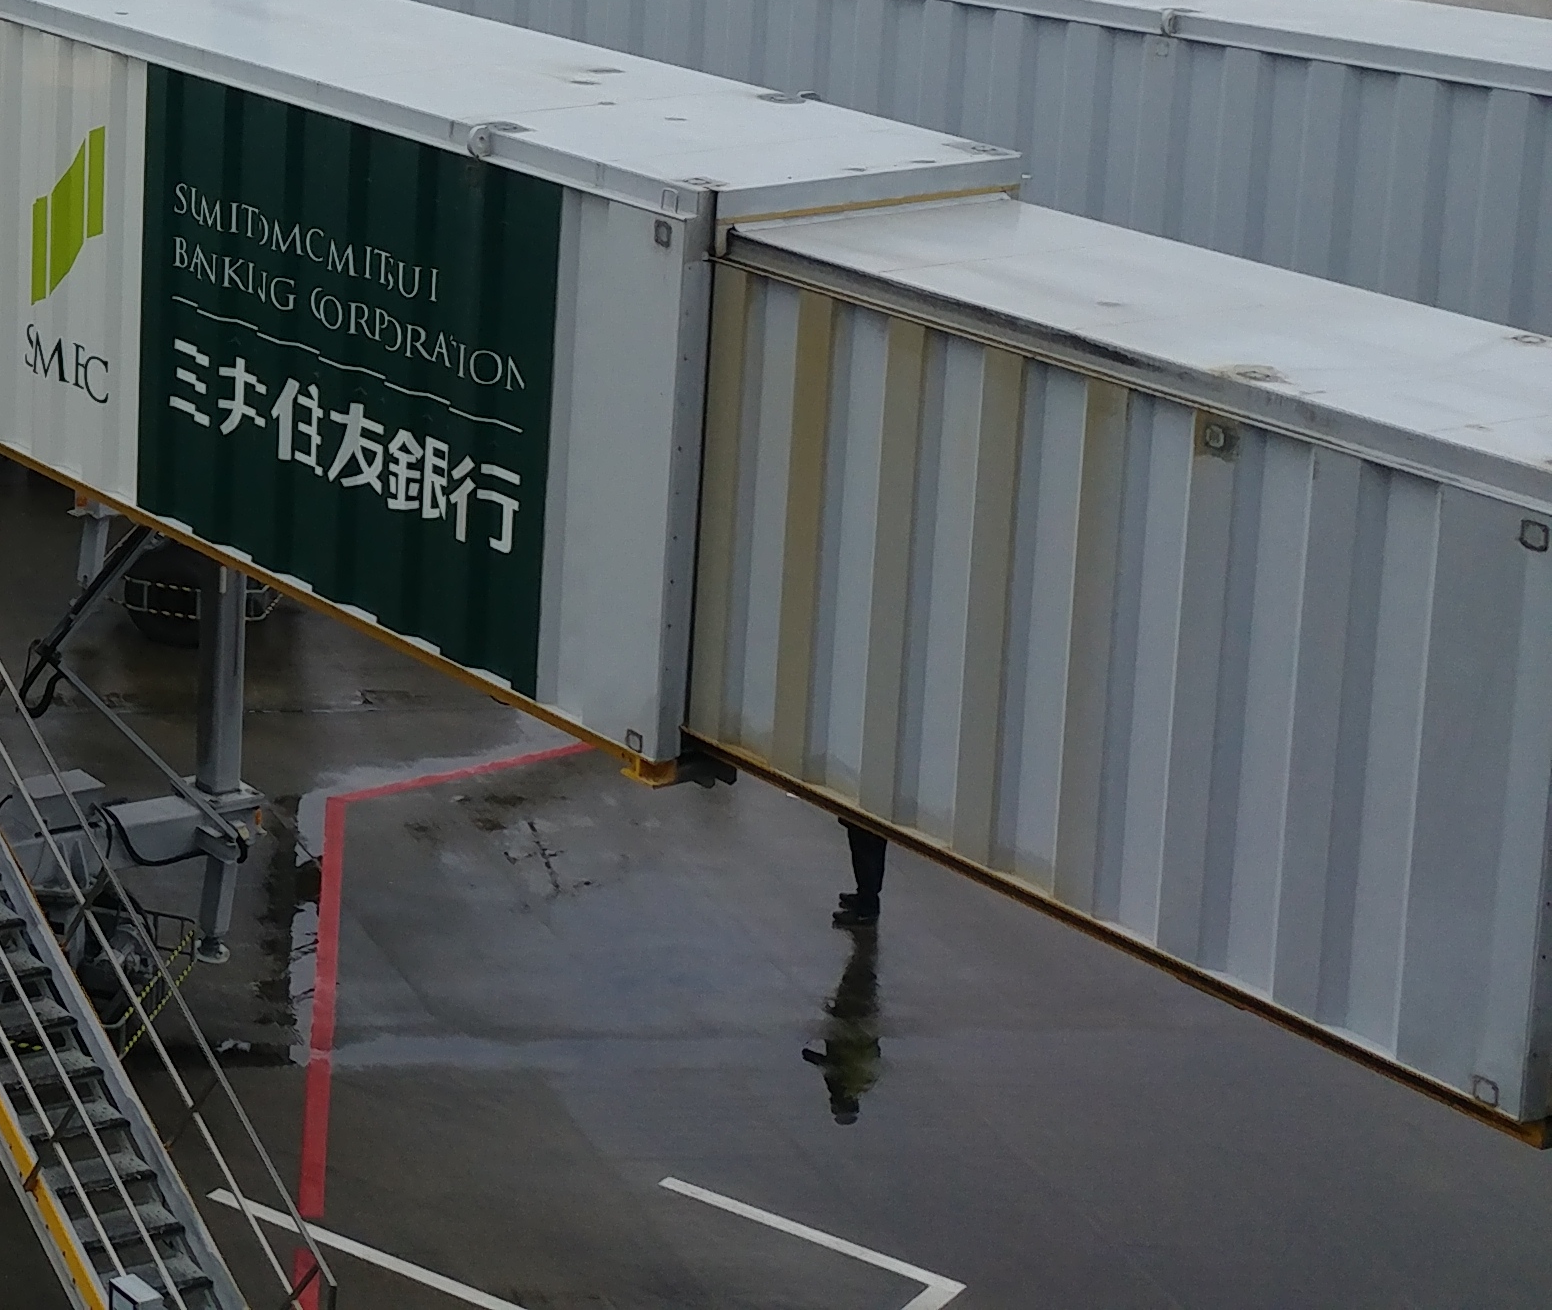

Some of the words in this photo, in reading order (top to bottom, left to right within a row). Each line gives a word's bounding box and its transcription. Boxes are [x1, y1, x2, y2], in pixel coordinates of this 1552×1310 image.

[171, 236, 296, 311] BANKING
[326, 238, 440, 303] MITSUI
[168, 338, 522, 554] 三井住友銀行
